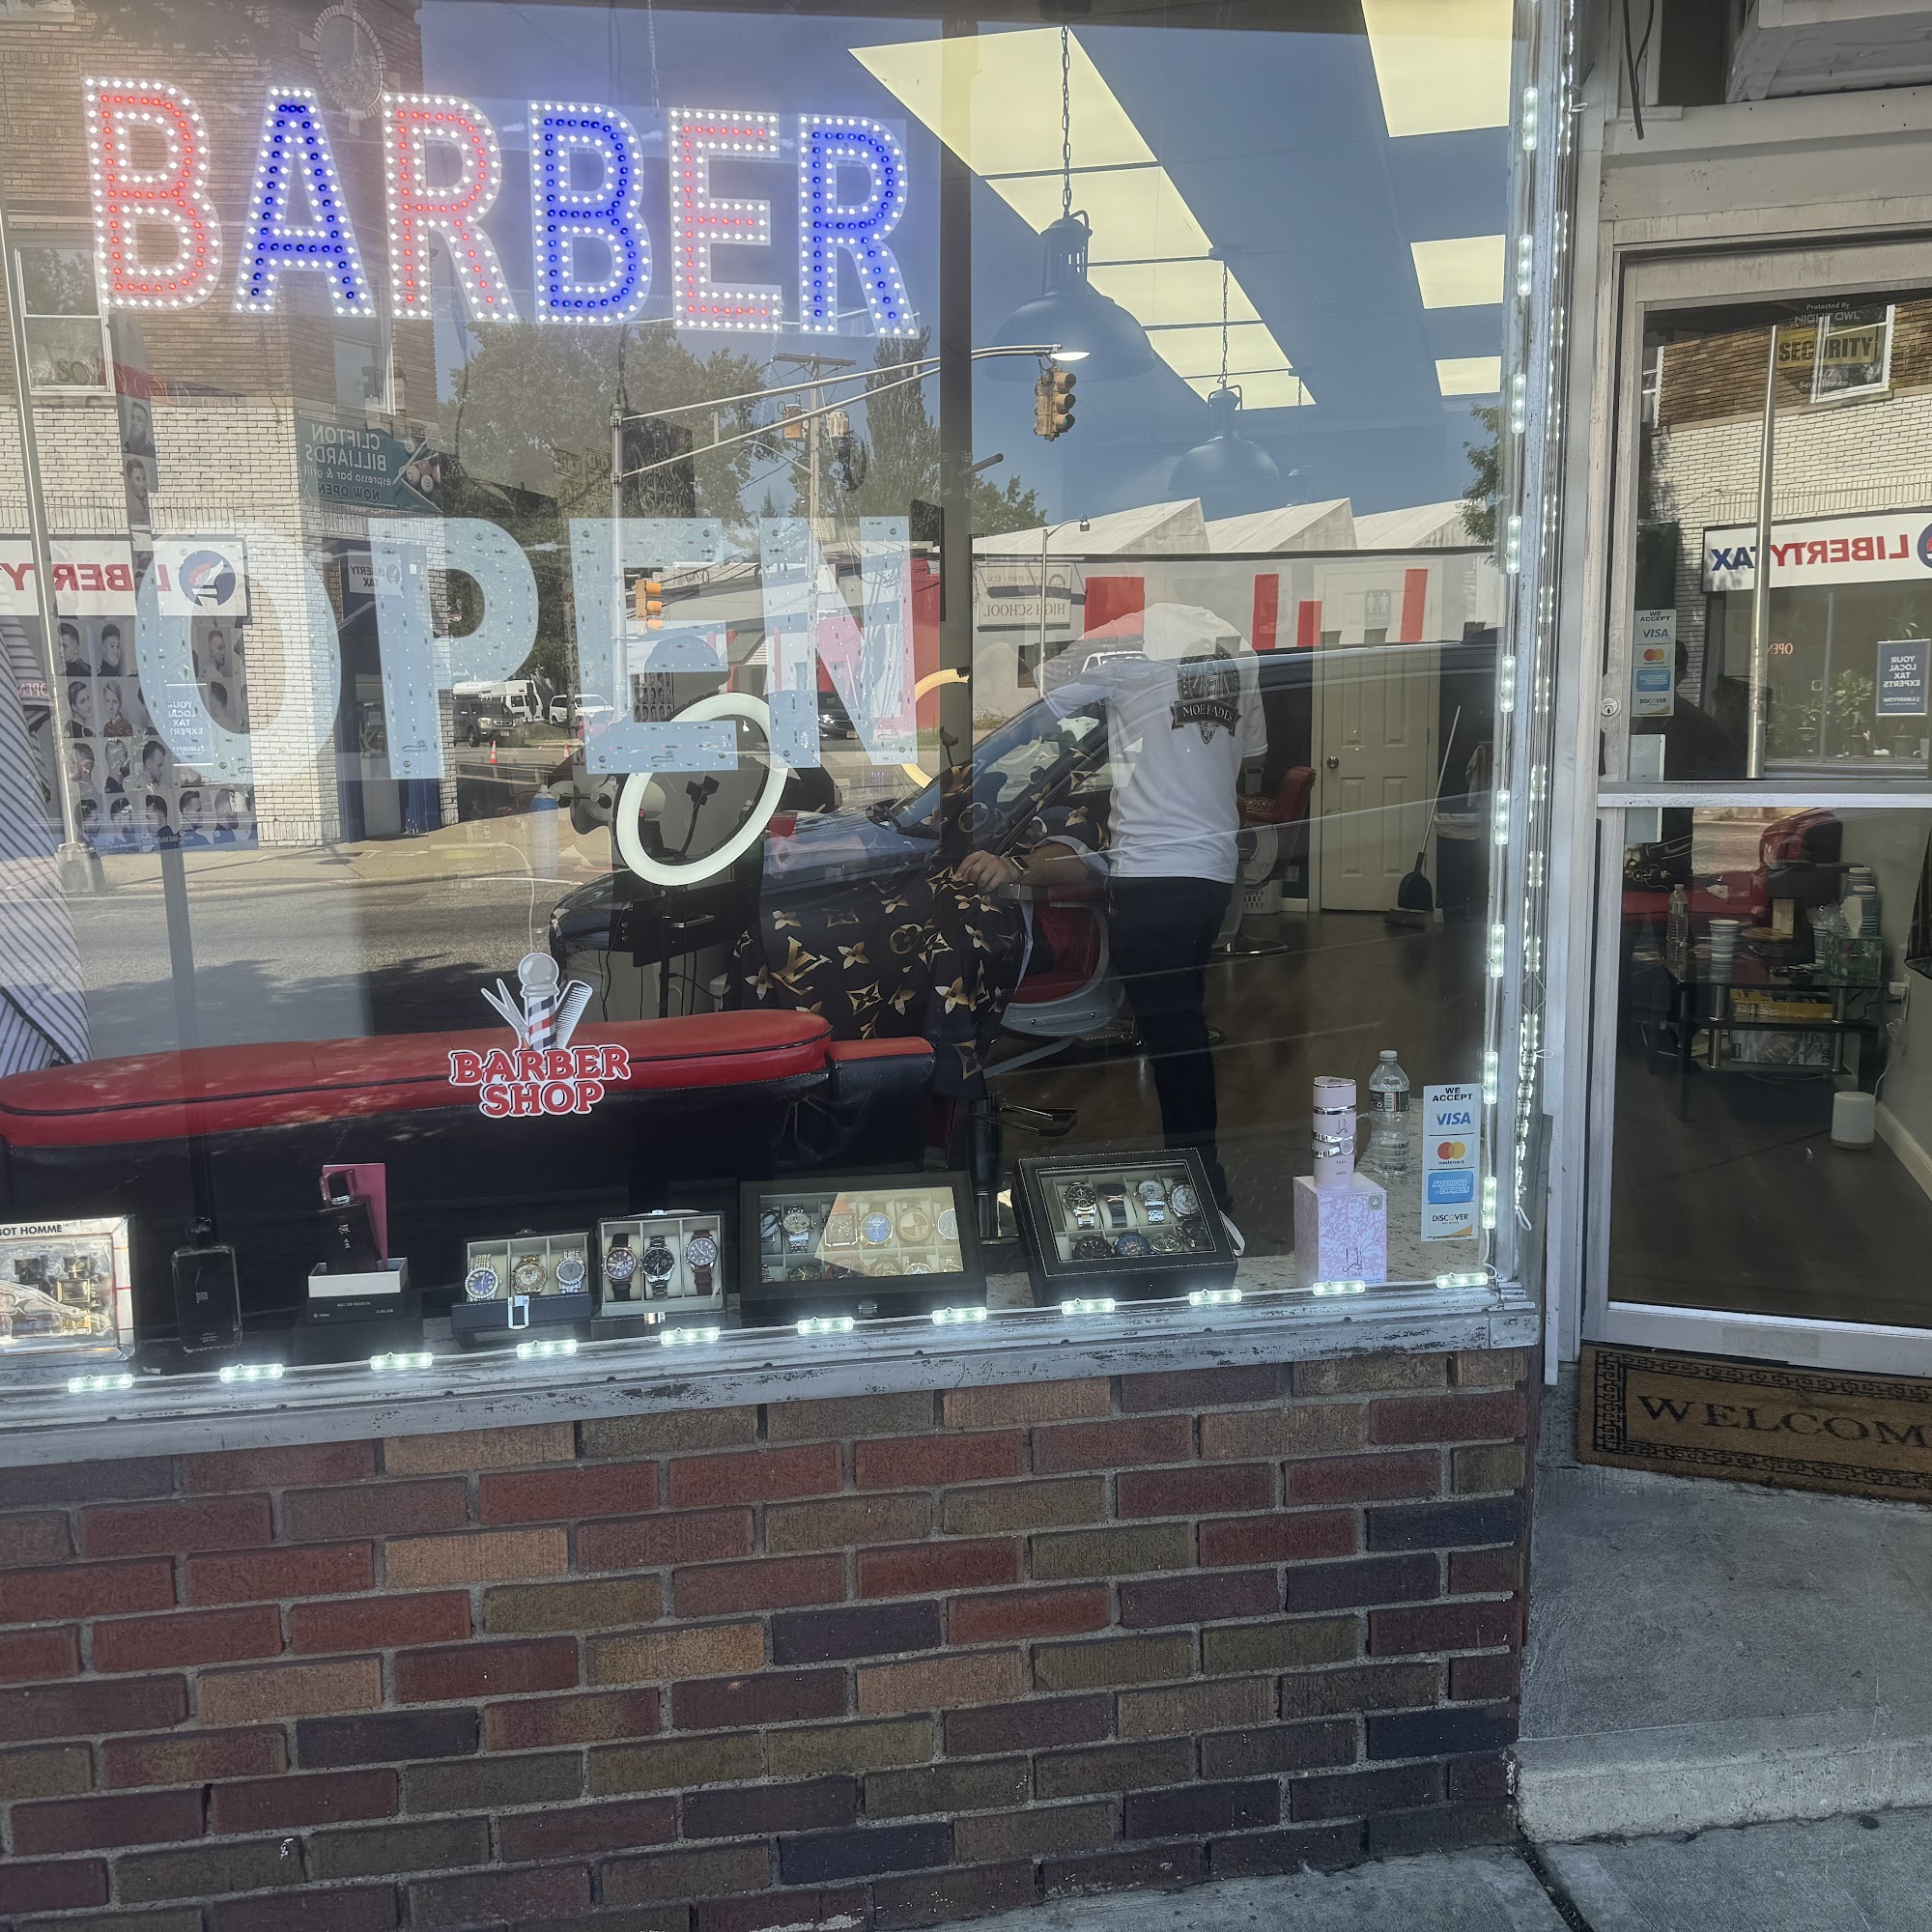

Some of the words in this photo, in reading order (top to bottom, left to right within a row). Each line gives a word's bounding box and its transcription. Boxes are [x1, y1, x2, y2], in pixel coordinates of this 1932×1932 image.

[83, 76, 921, 339] BARBER
[1835, 310, 1861, 320] OWL
[1643, 628, 1669, 638] VISA
[135, 515, 919, 781] OPEN
[1182, 704, 1206, 717] MOE
[1207, 704, 1233, 722] FADES
[449, 1045, 631, 1086] BARBER
[480, 1080, 605, 1118] SHOP
[1435, 1112, 1471, 1125] VISA
[1433, 1213, 1468, 1222] DISCOVER
[20, 1224, 63, 1236] HOMME
[1637, 1395, 1932, 1449] WELCOM
